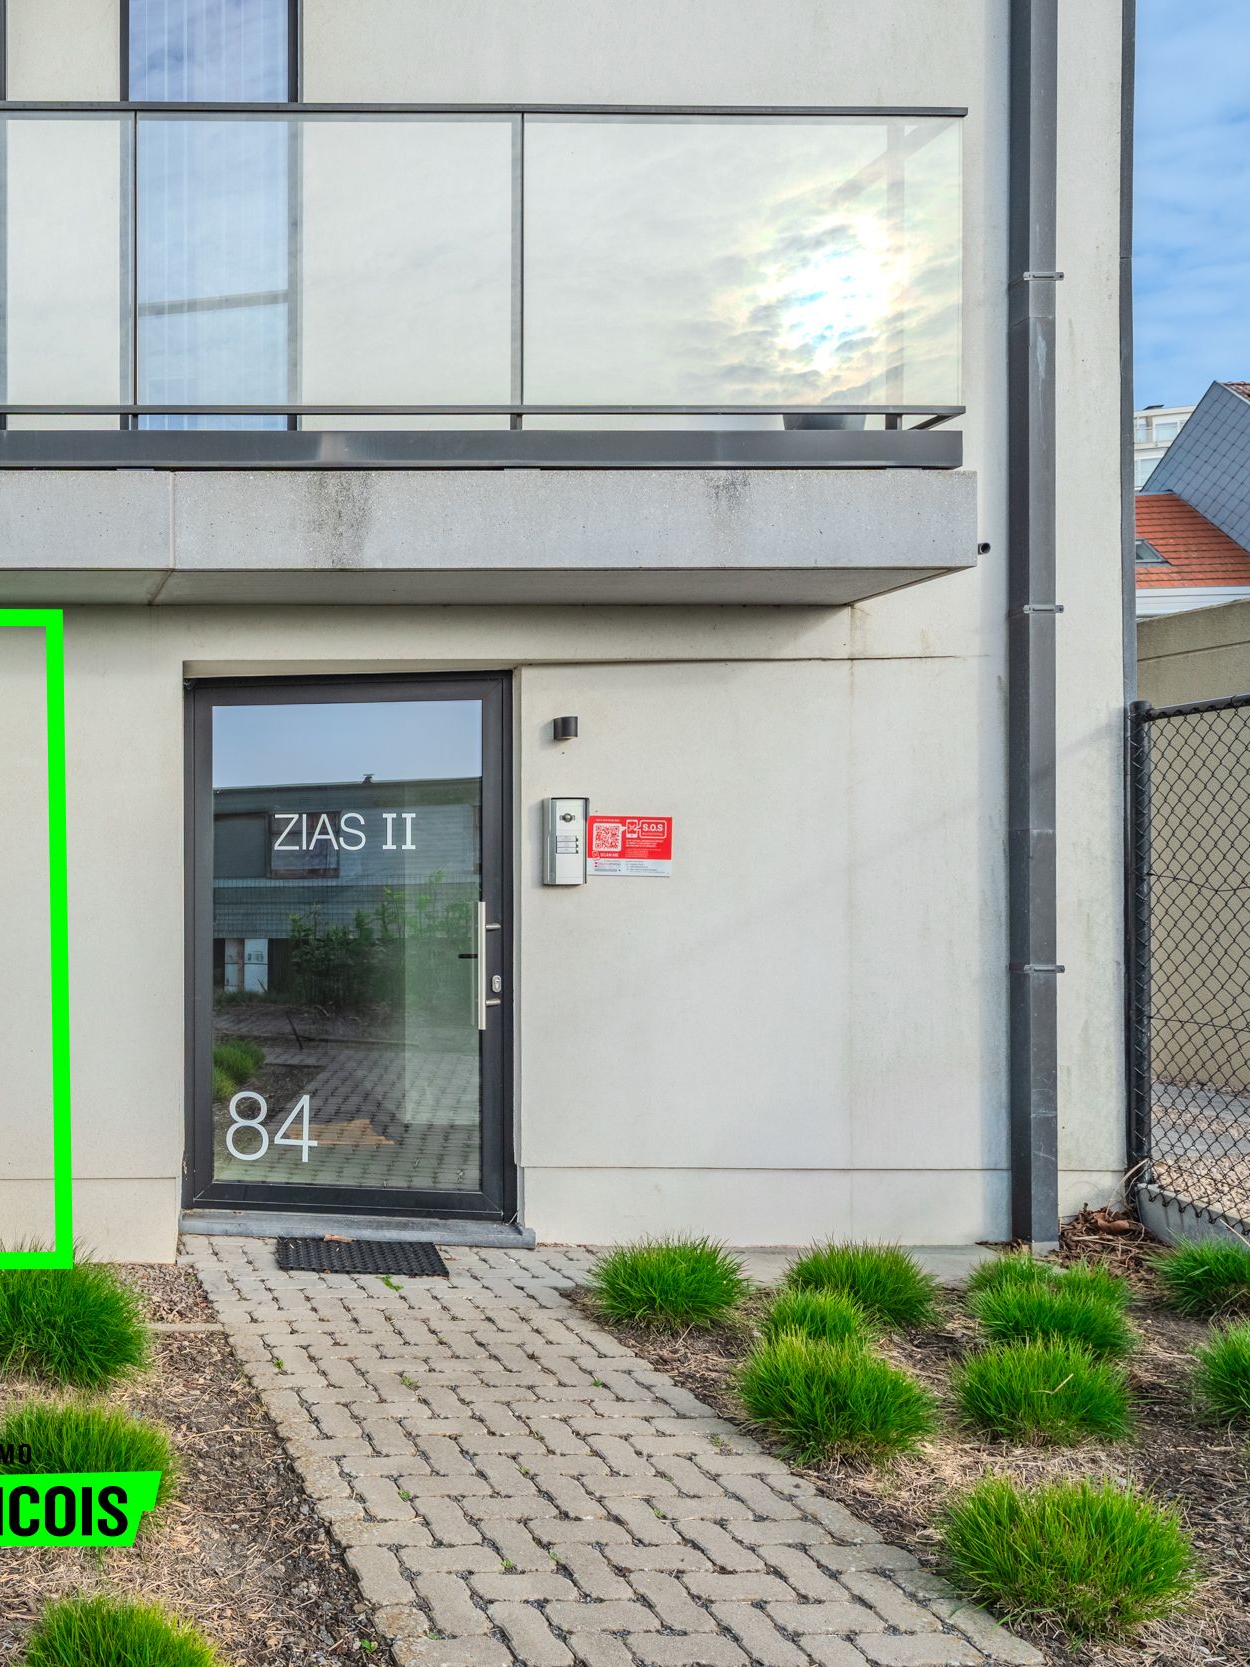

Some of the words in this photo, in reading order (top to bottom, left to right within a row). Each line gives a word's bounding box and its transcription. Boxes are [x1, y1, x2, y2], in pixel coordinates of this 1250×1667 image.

[273, 812, 367, 851] ZIAS
[382, 812, 417, 850] II
[642, 823, 664, 832] S.O.S
[225, 1091, 318, 1163] 84
